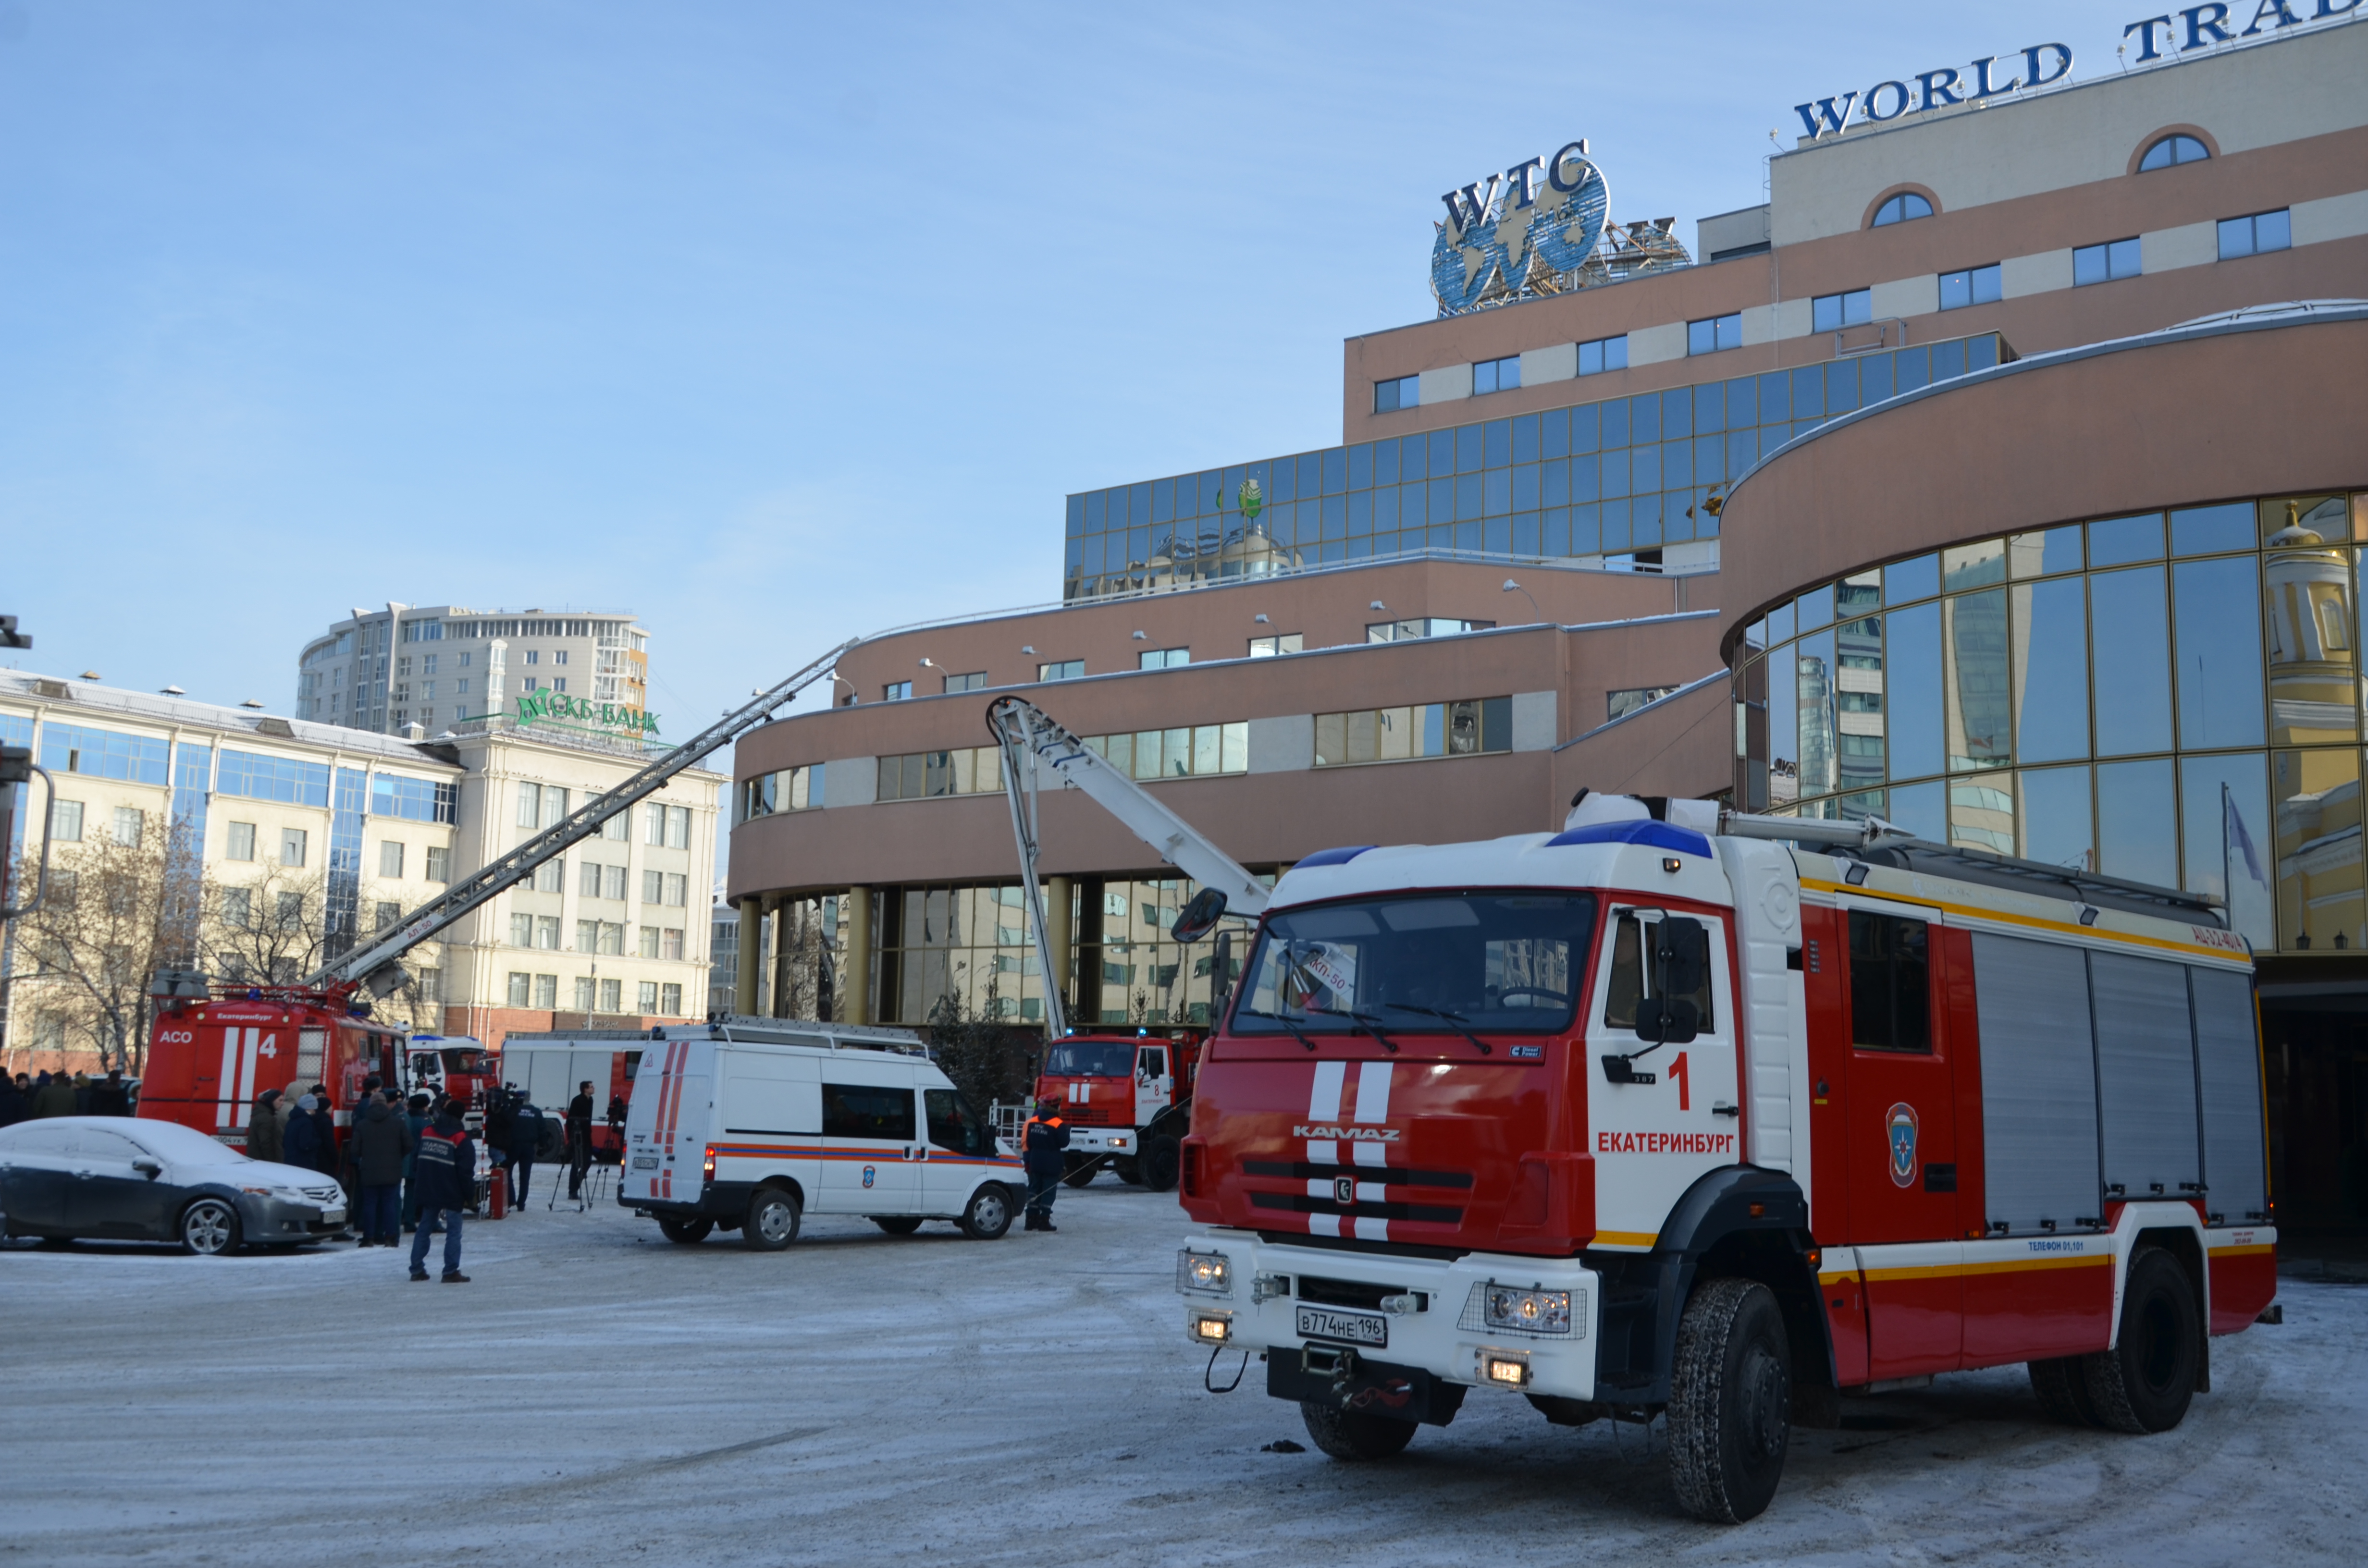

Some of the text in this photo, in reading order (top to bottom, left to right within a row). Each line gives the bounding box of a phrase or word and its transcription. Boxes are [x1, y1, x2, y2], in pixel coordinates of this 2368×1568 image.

[1794, 42, 2074, 141] WORLD
[1442, 138, 1591, 233] WTC
[551, 693, 661, 735] СКБ-БАНК
[218, 1013, 272, 1021] Екатеринбург
[160, 1031, 192, 1043] АСО
[259, 1033, 277, 1059] 4
[1155, 1084, 1159, 1096] 8
[1669, 1052, 1690, 1111] 1
[1293, 1126, 1400, 1141] KAMAZ
[1598, 1132, 1734, 1153] ЕКАТЕРИНБУРГ
[2028, 1241, 2084, 1252] ТЕЛЕФОН 01,101
[1302, 1312, 1381, 1337] В774НЕ 196
